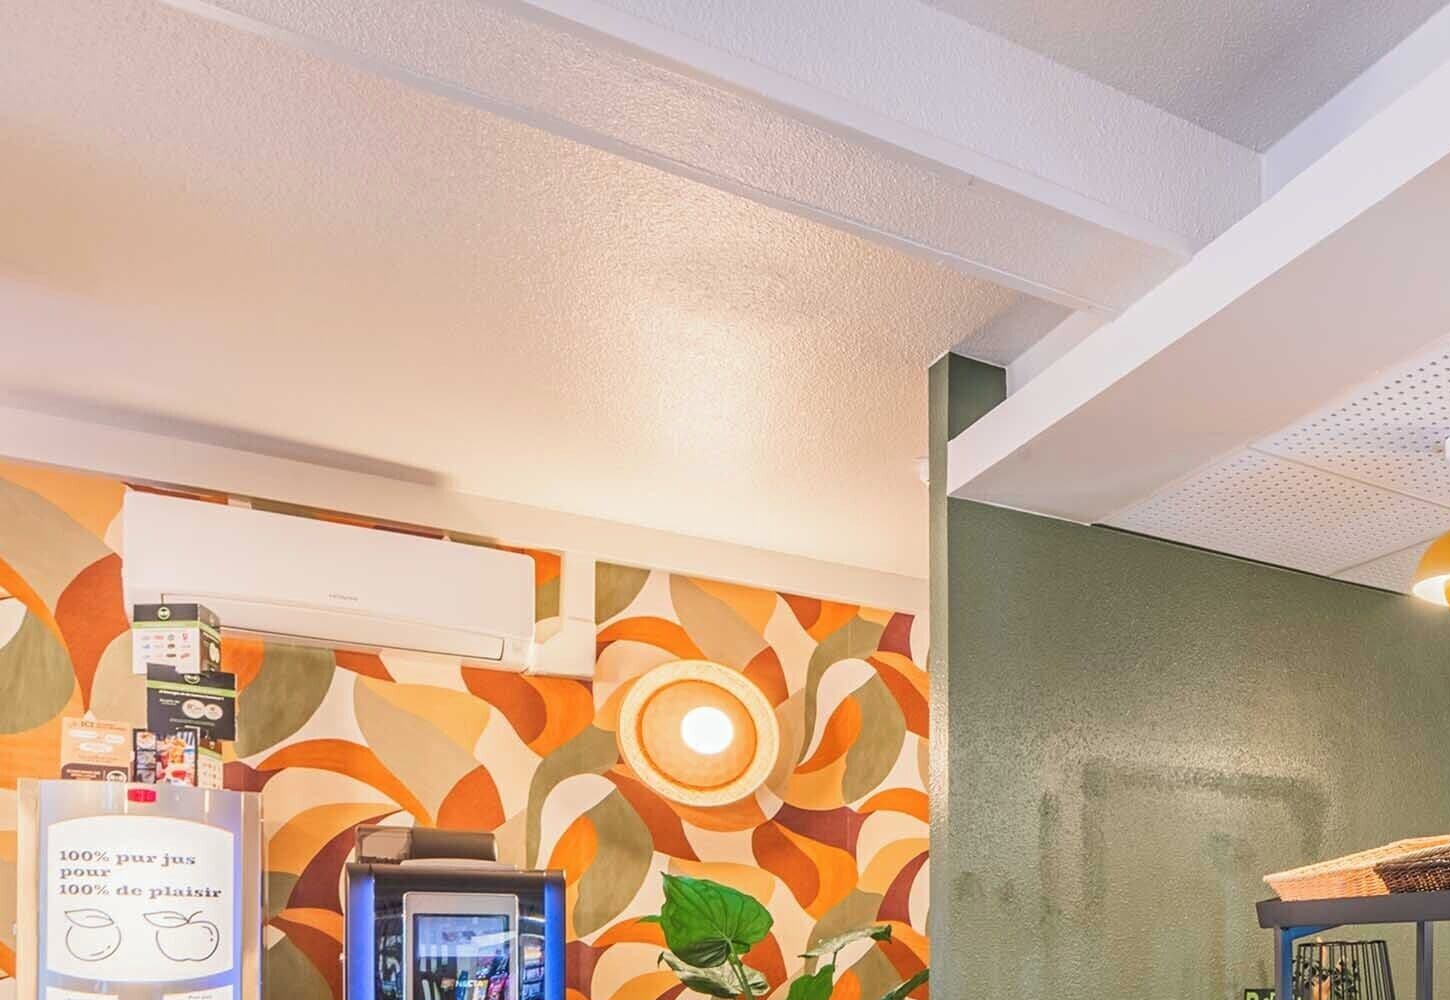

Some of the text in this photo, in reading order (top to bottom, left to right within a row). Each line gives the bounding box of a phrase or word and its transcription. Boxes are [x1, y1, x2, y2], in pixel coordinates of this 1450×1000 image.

[59, 850, 196, 867] 100% pur jus
[60, 867, 111, 879] pour
[59, 884, 222, 899] 100% de plaisir
